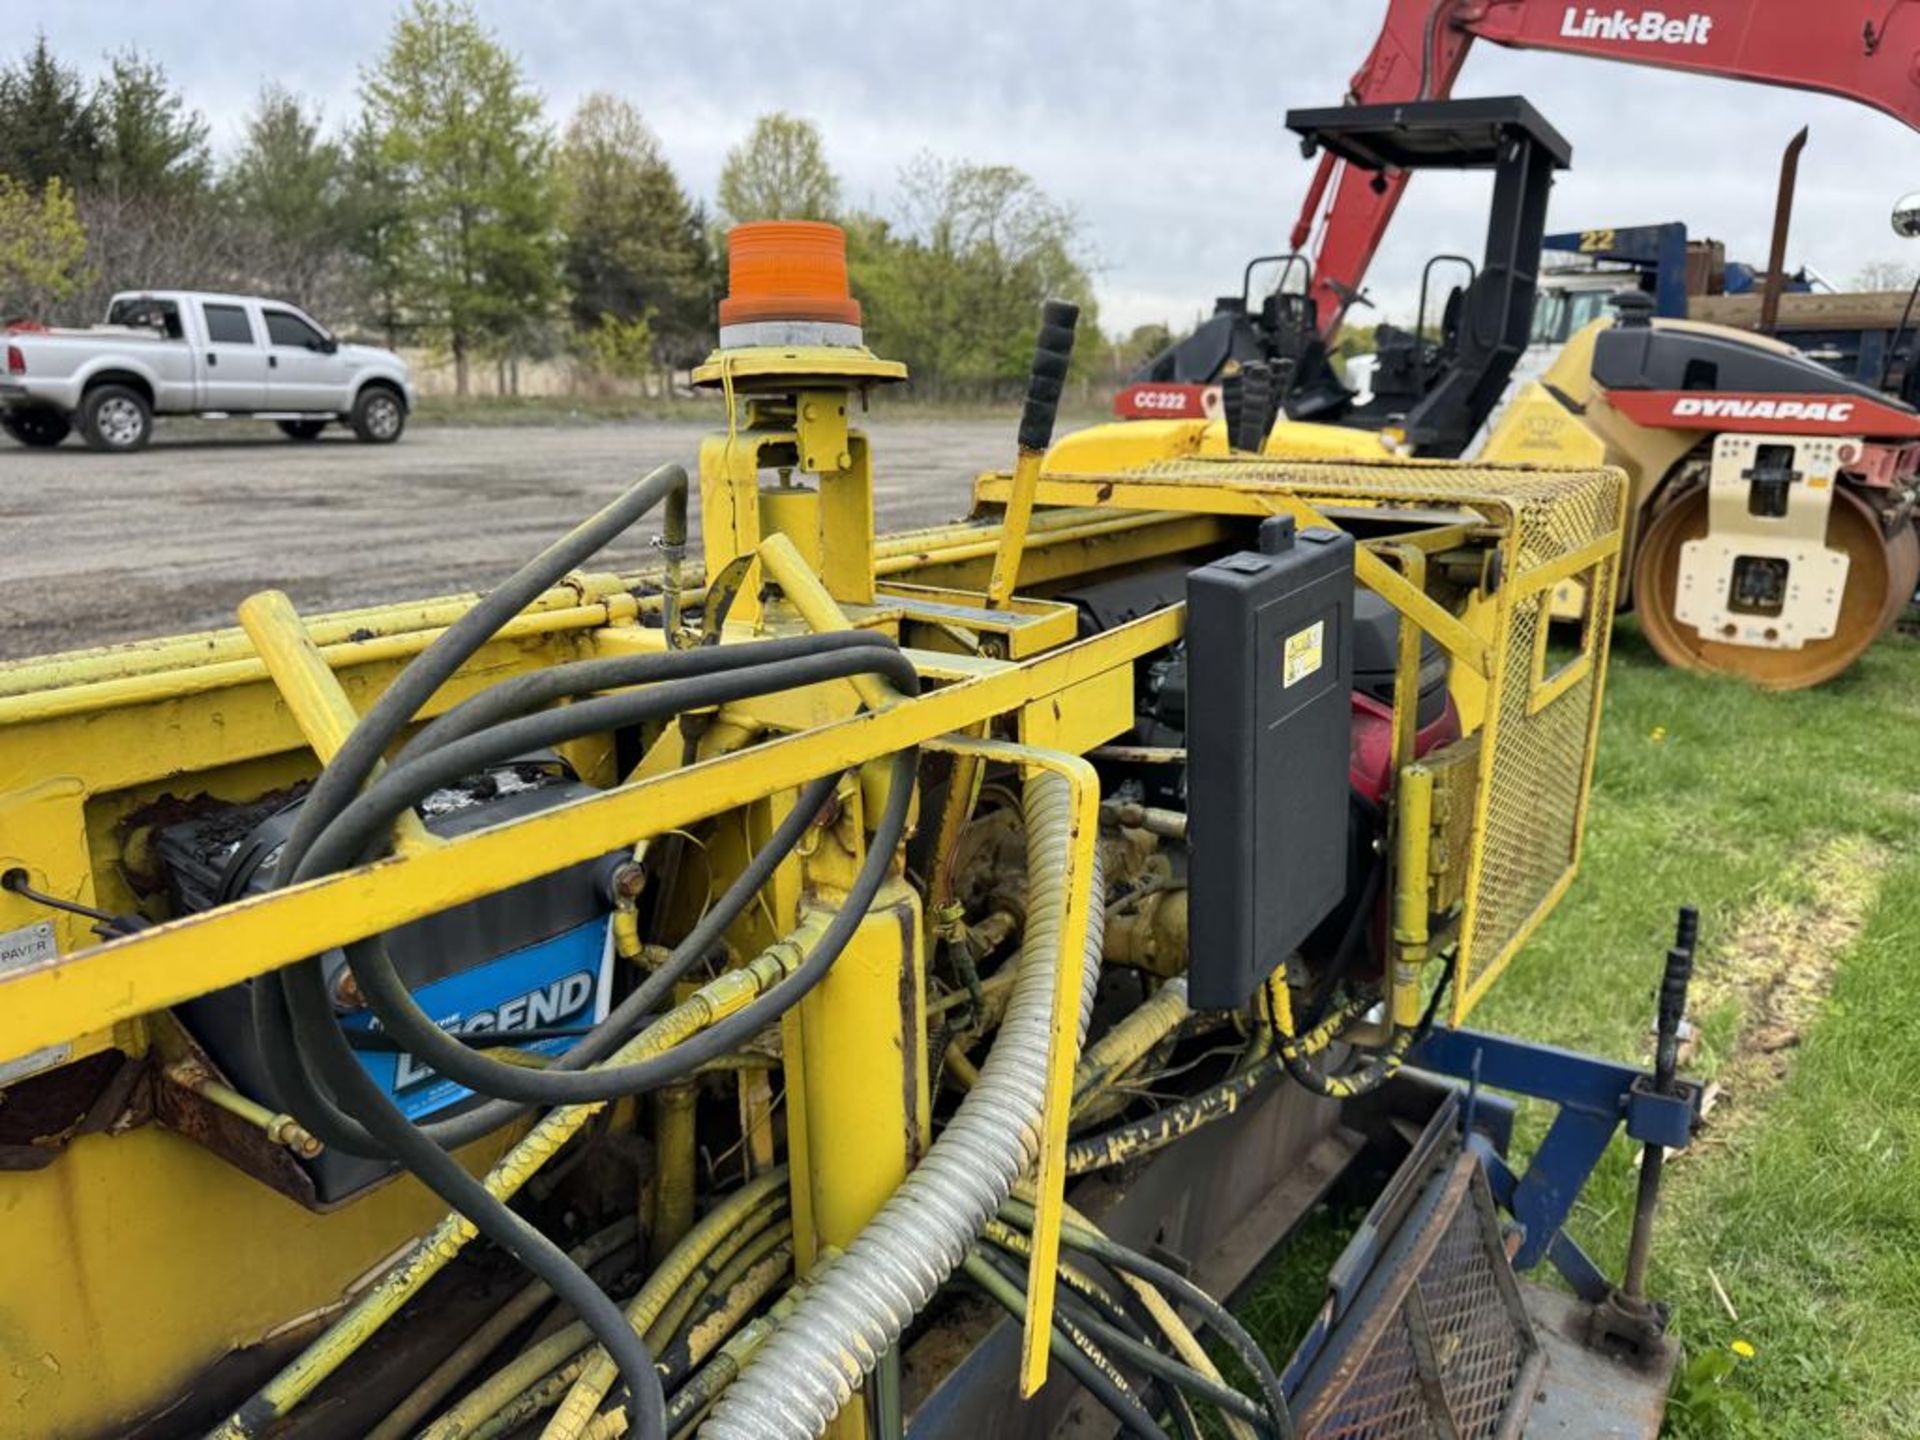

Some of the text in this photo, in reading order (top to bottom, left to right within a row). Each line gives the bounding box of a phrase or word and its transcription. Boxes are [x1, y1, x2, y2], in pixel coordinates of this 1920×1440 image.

[1560, 6, 1713, 45] Link-Belt
[1580, 229, 1616, 253] 22
[1134, 391, 1187, 410] CC222
[1672, 398, 1855, 422] DYNAPAC
[394, 970, 592, 1091] LGEND
